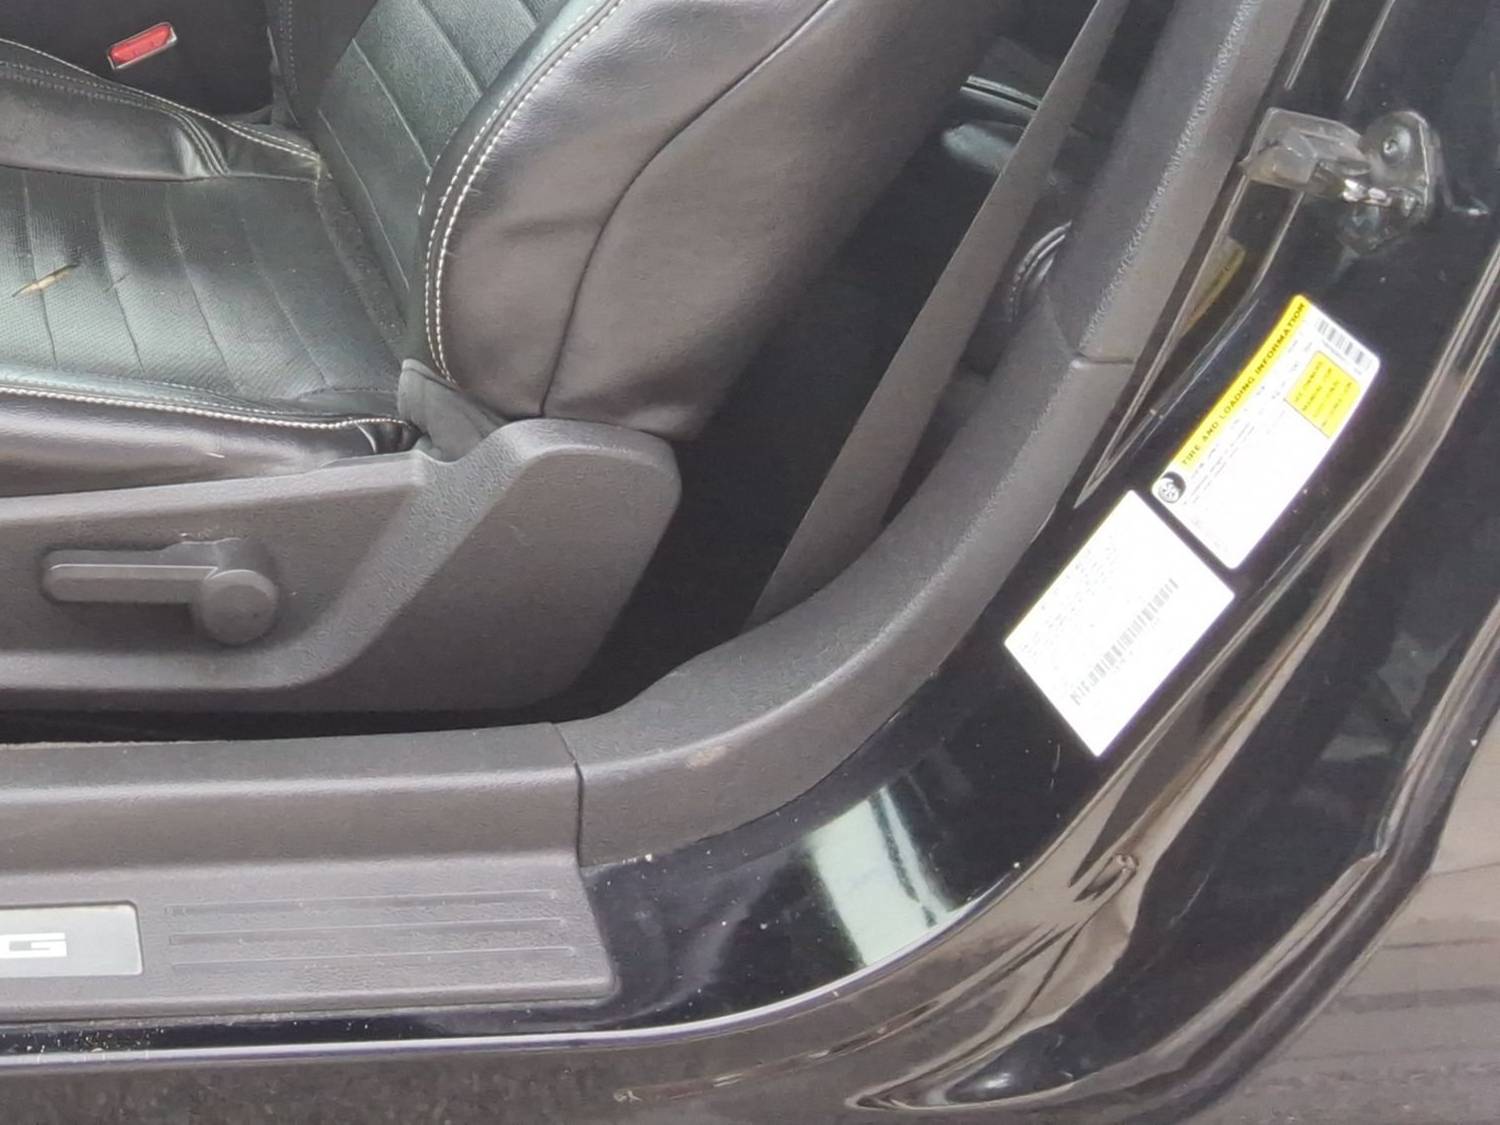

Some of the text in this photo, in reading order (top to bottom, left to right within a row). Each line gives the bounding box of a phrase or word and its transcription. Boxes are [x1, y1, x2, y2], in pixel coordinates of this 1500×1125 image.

[1182, 443, 1201, 465] TIRE
[1202, 420, 1219, 442] AND
[1219, 376, 1255, 420] LOADING
[1255, 302, 1305, 375] INFORMATION
